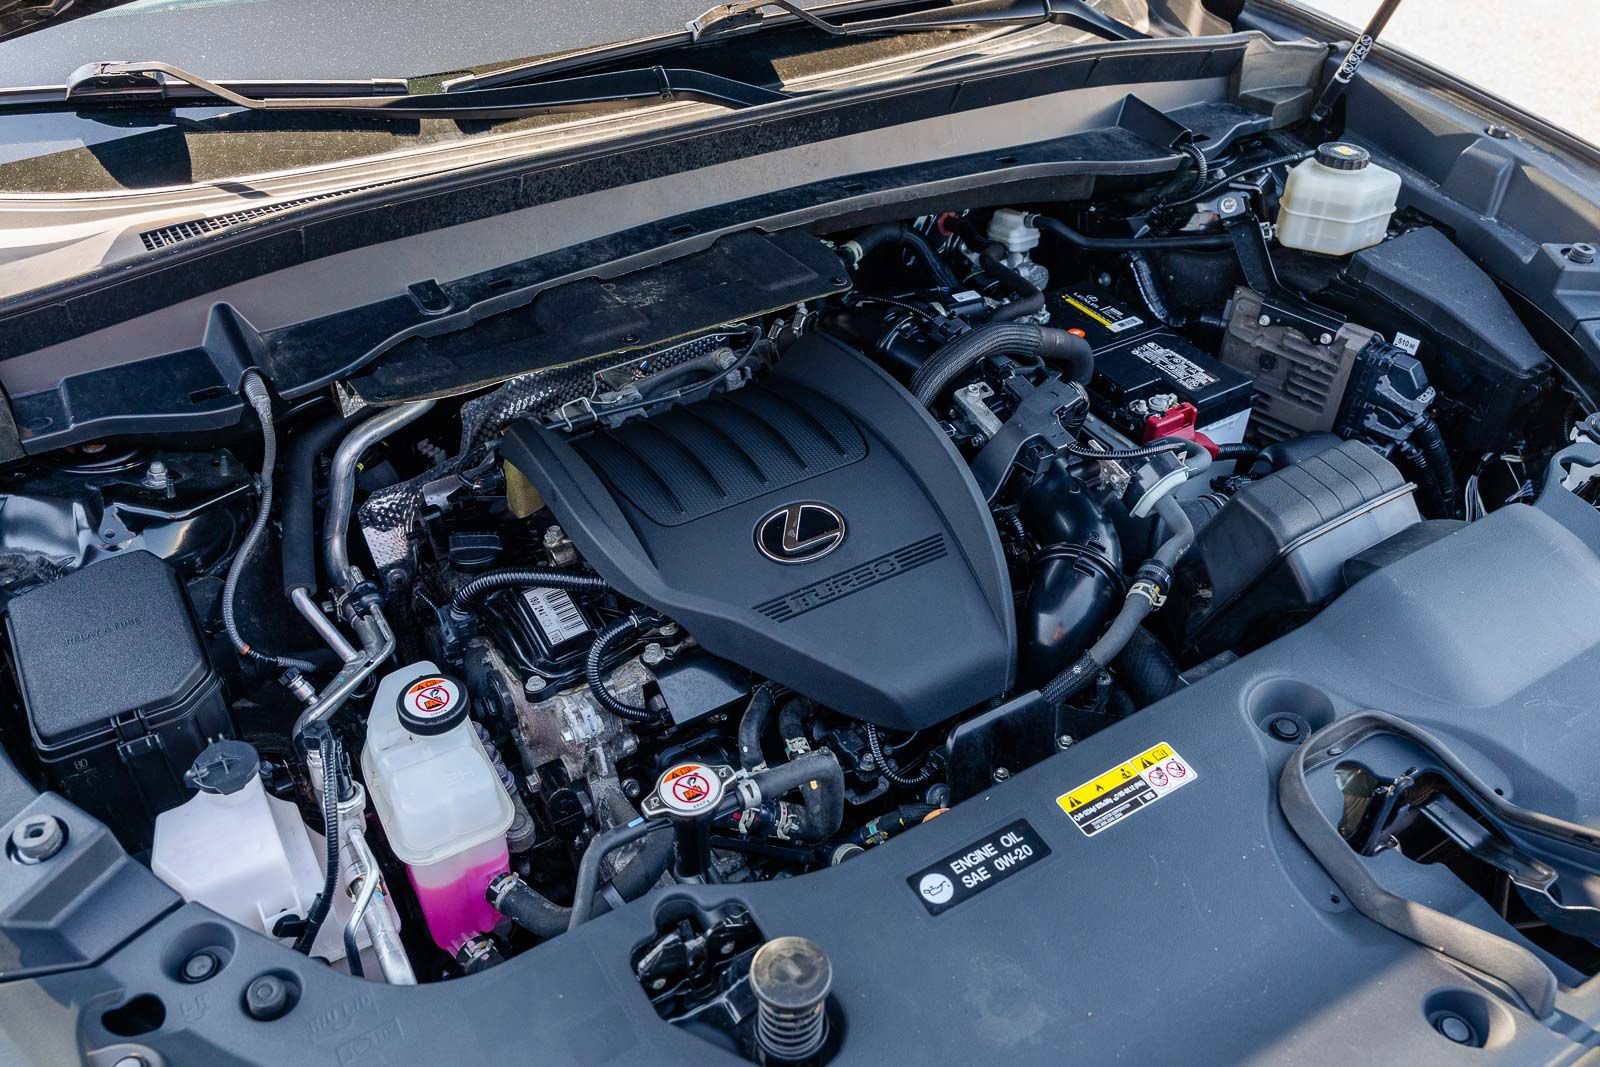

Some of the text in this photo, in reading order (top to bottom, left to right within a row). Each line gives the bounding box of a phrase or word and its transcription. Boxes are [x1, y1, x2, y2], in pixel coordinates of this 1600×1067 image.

[789, 557, 898, 608] TURBO
[949, 831, 1024, 875] ENGINE OIL
[961, 844, 1034, 889] SAE 0W-20
